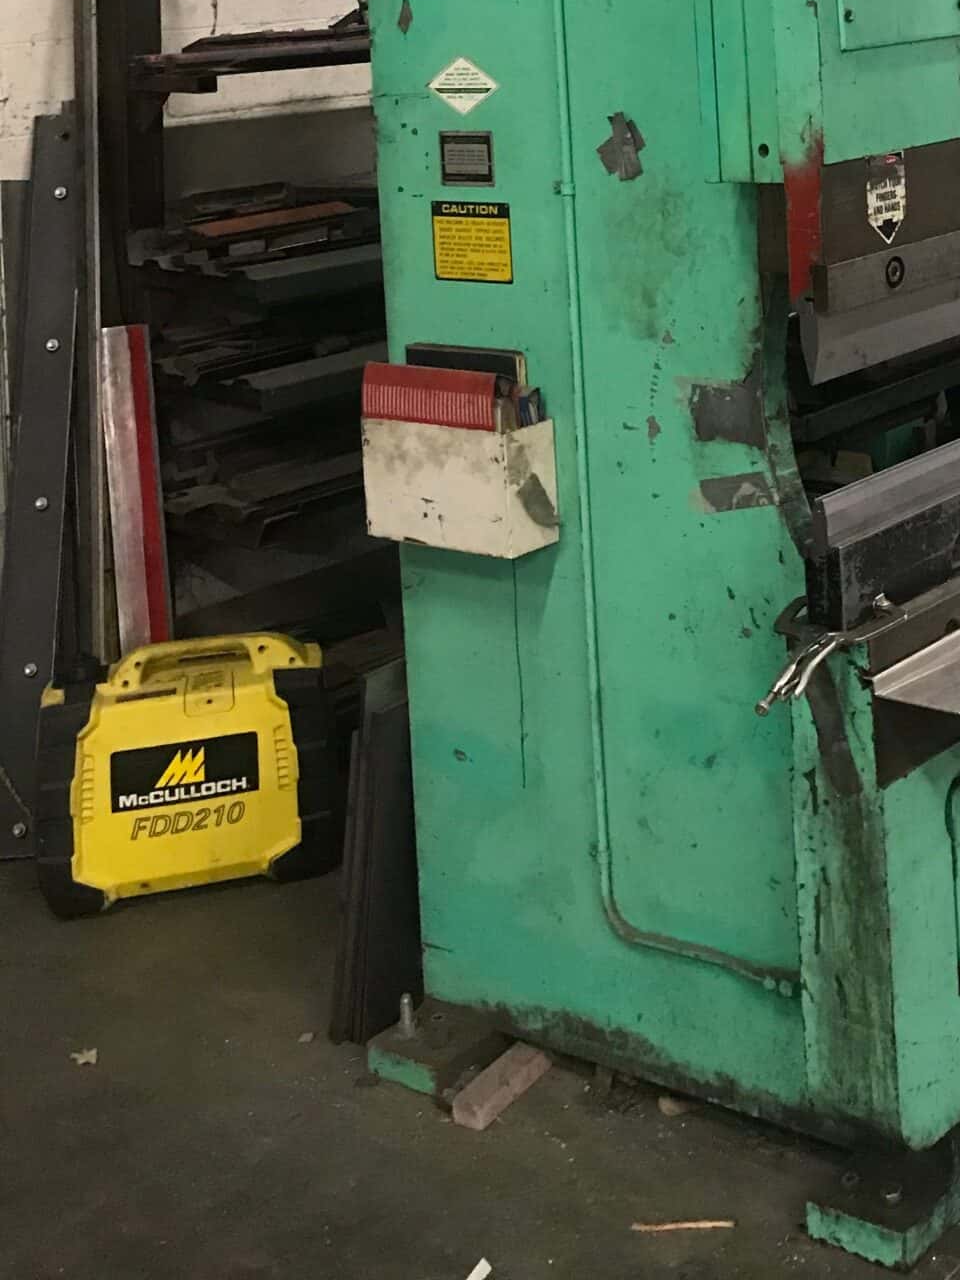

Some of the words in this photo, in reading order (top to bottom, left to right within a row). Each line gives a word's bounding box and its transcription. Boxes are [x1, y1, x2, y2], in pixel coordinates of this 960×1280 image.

[442, 203, 498, 215] CAUTION
[119, 777, 247, 808] McCULLOCH
[131, 800, 245, 840] FDD210
